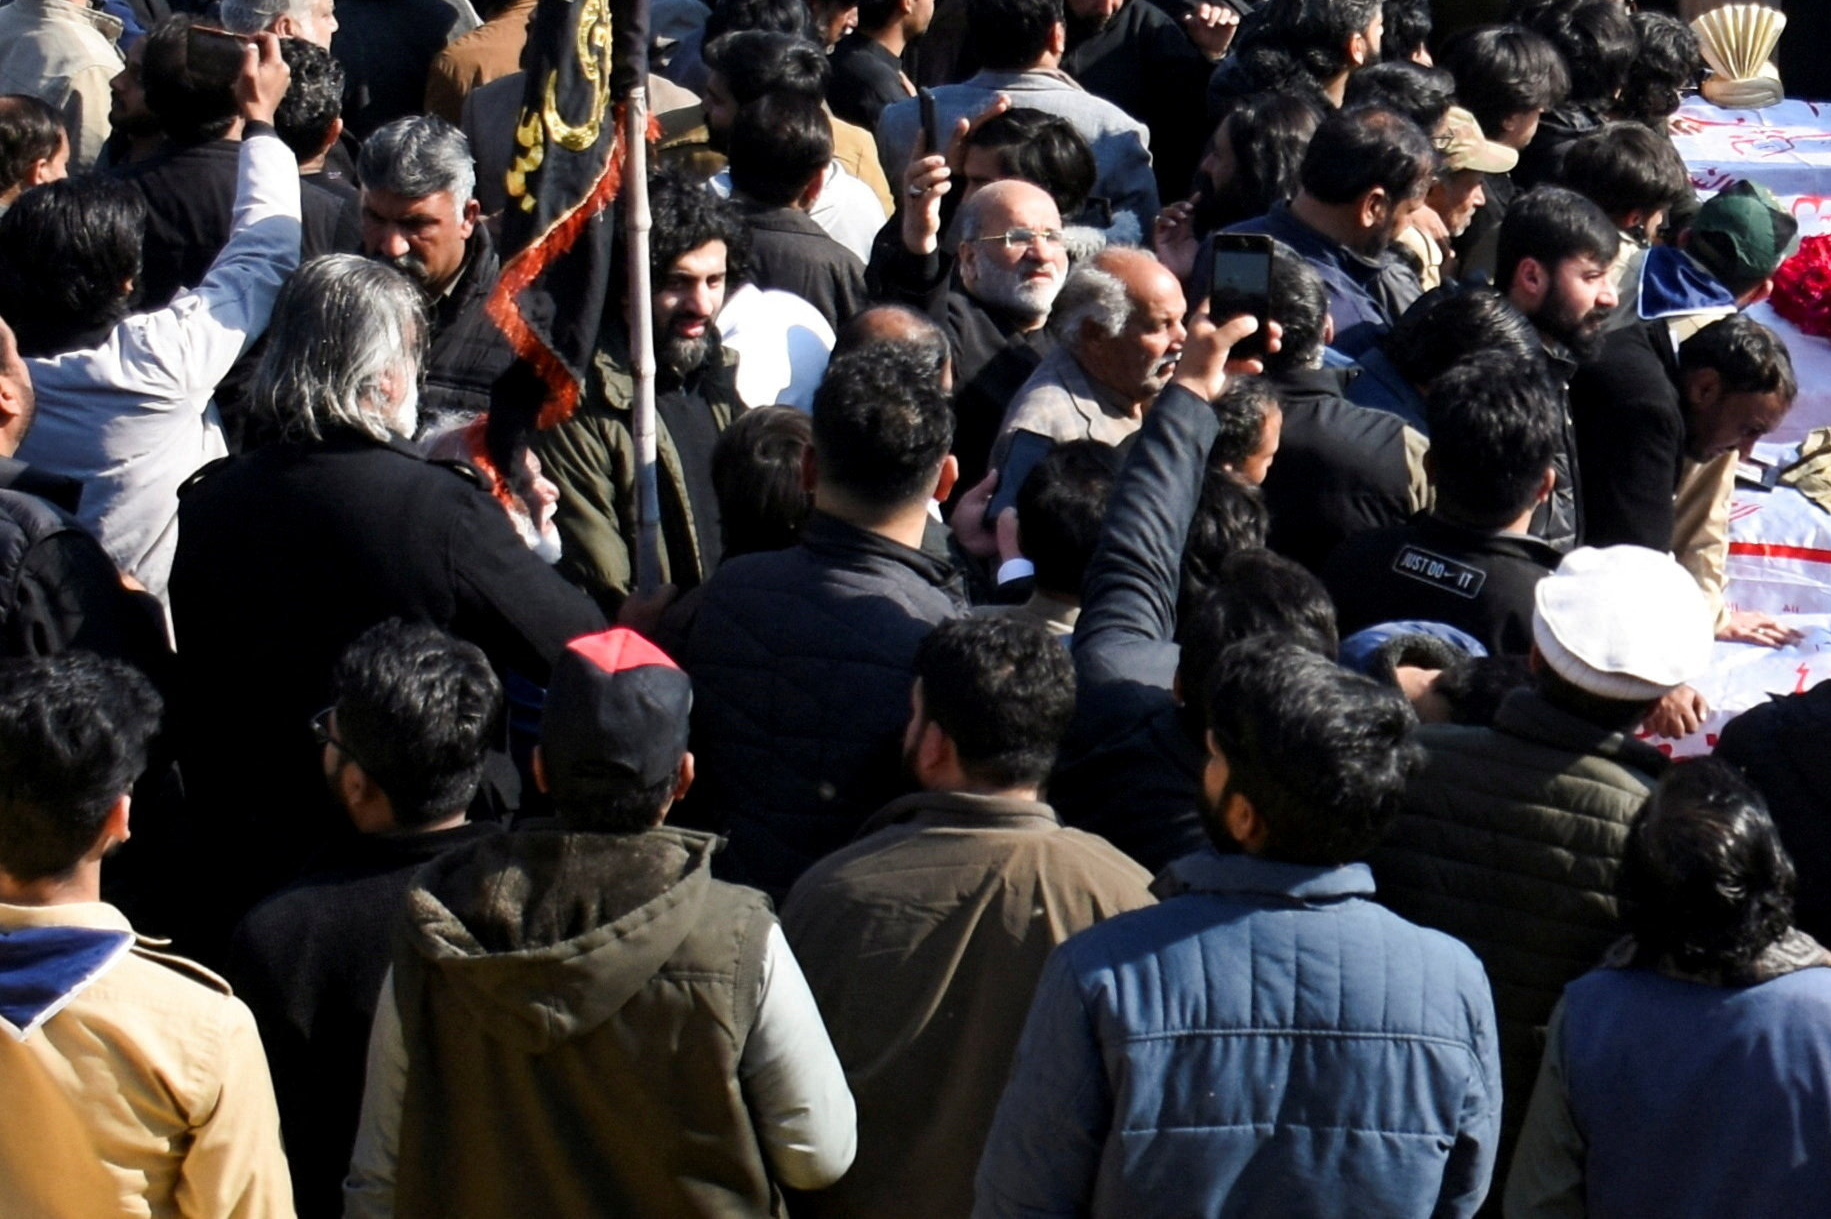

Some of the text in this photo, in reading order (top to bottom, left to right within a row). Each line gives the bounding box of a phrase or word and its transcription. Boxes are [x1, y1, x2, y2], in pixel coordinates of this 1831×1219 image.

[1400, 552, 1474, 589] JUST DO IT
